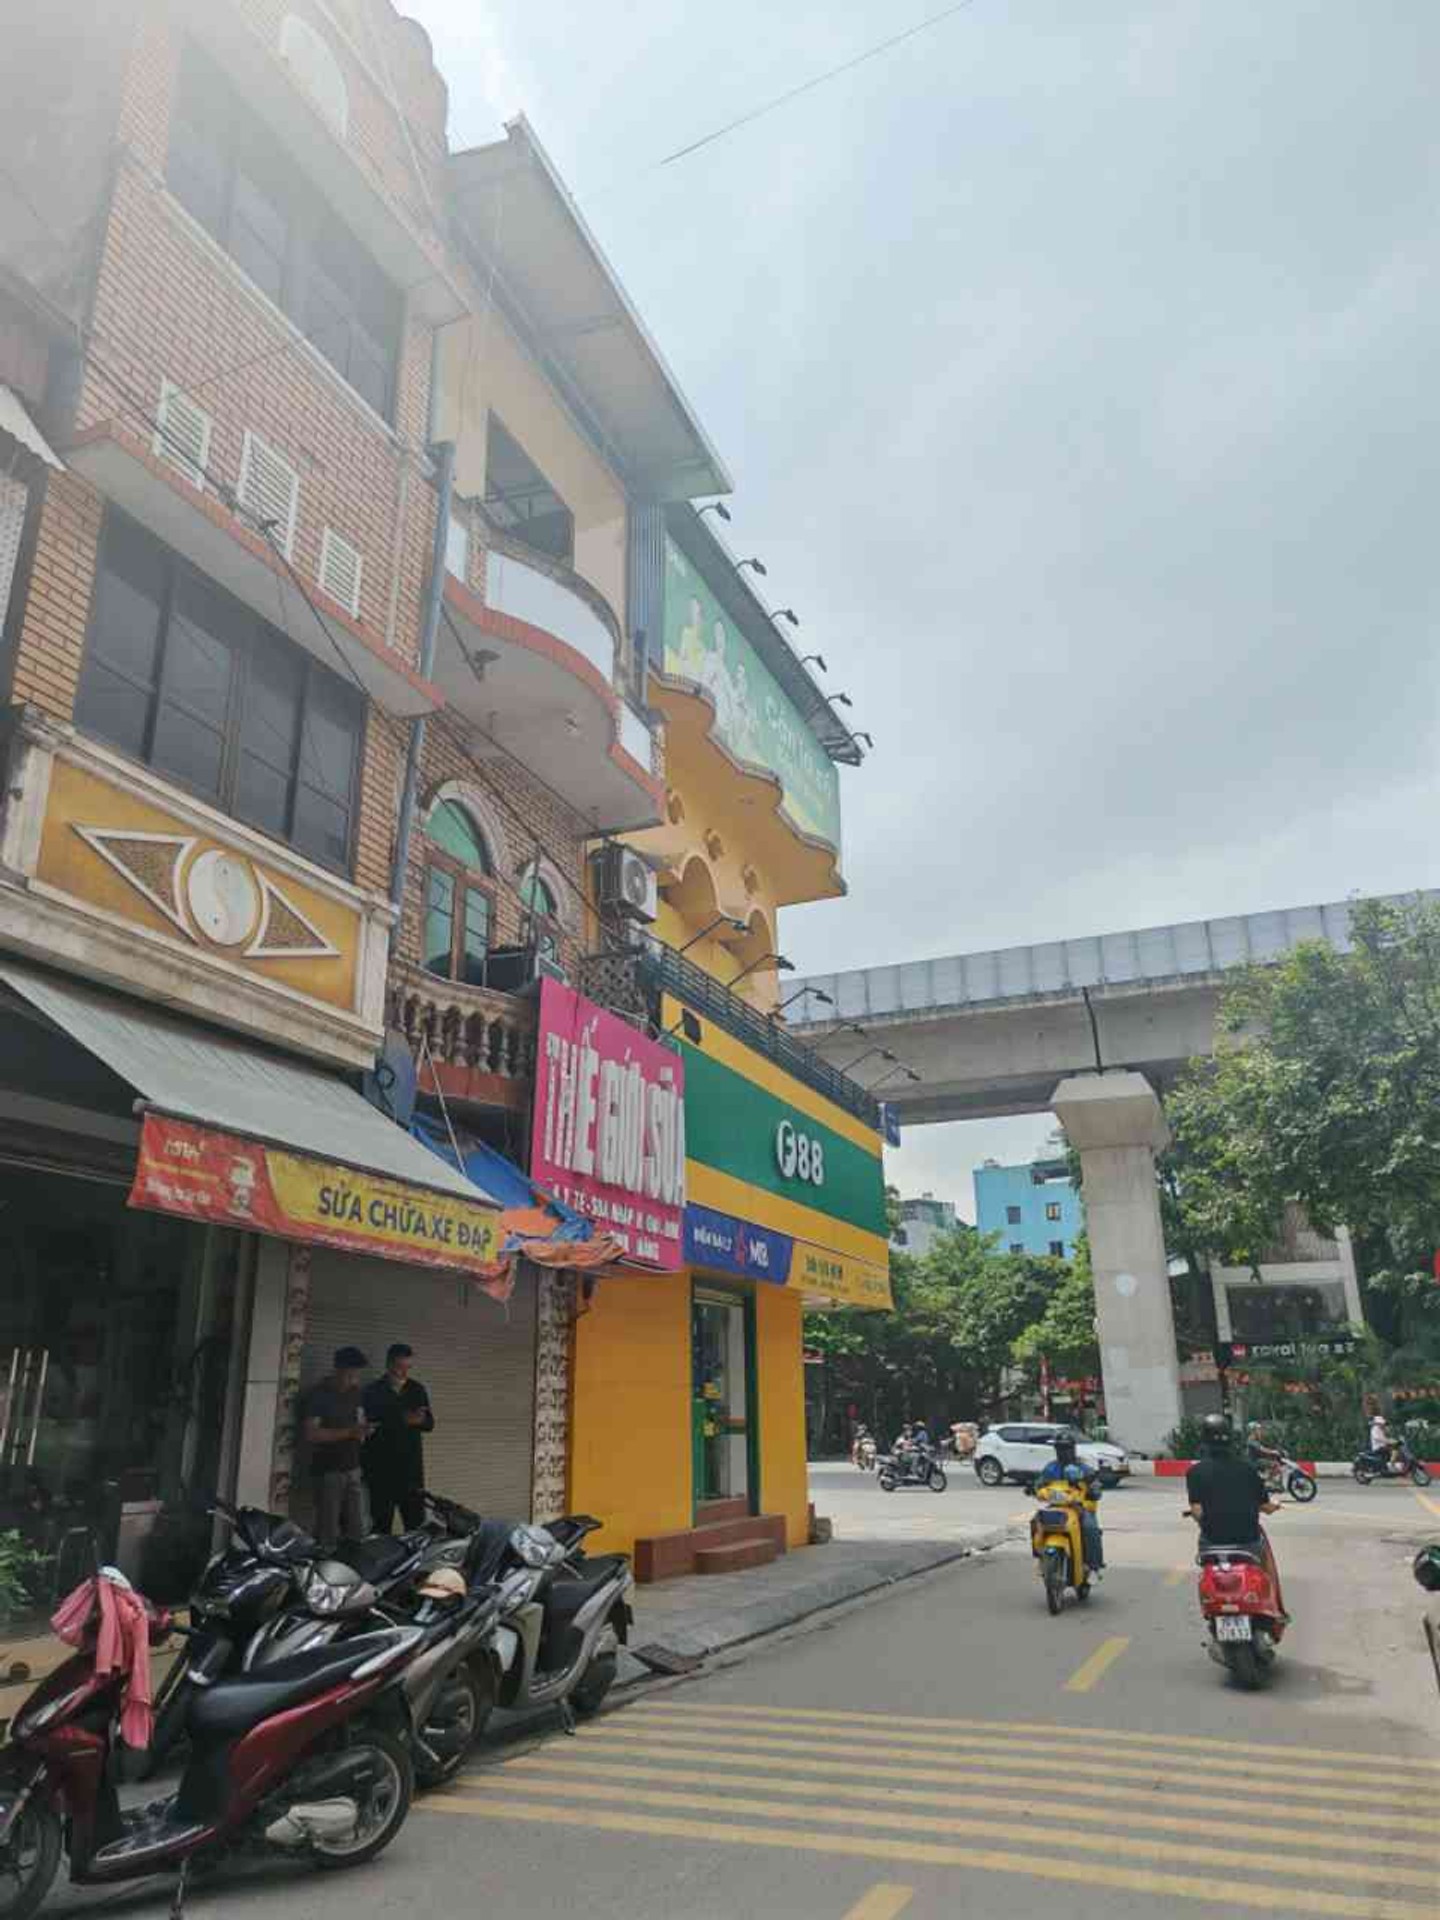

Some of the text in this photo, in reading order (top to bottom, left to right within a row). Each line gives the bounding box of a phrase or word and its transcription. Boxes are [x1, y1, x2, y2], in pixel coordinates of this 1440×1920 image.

[544, 1015, 687, 1208] THẾ GIỚI SỮA
[318, 1180, 493, 1256] SỬA CHỮA XE ĐẠP
